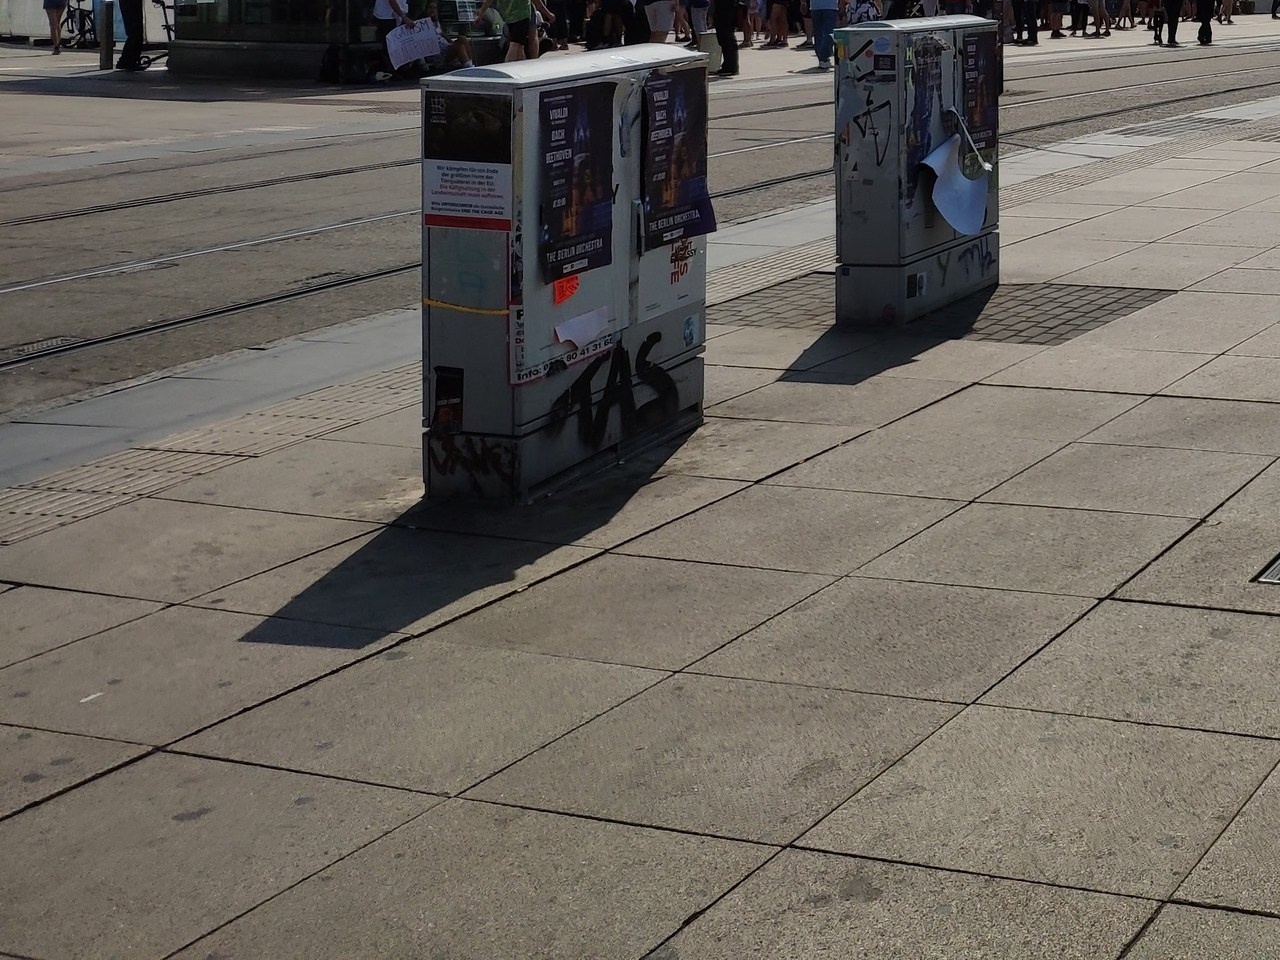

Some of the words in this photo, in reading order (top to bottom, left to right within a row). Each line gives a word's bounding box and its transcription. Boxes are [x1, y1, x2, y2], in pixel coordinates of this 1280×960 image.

[547, 250, 558, 263] THE
[558, 244, 576, 259] BERLIN
[576, 238, 604, 255] ORCHESTRA
[517, 366, 542, 381] Info:
[567, 352, 578, 363] 80
[580, 346, 591, 357] 41
[592, 341, 603, 352] 31
